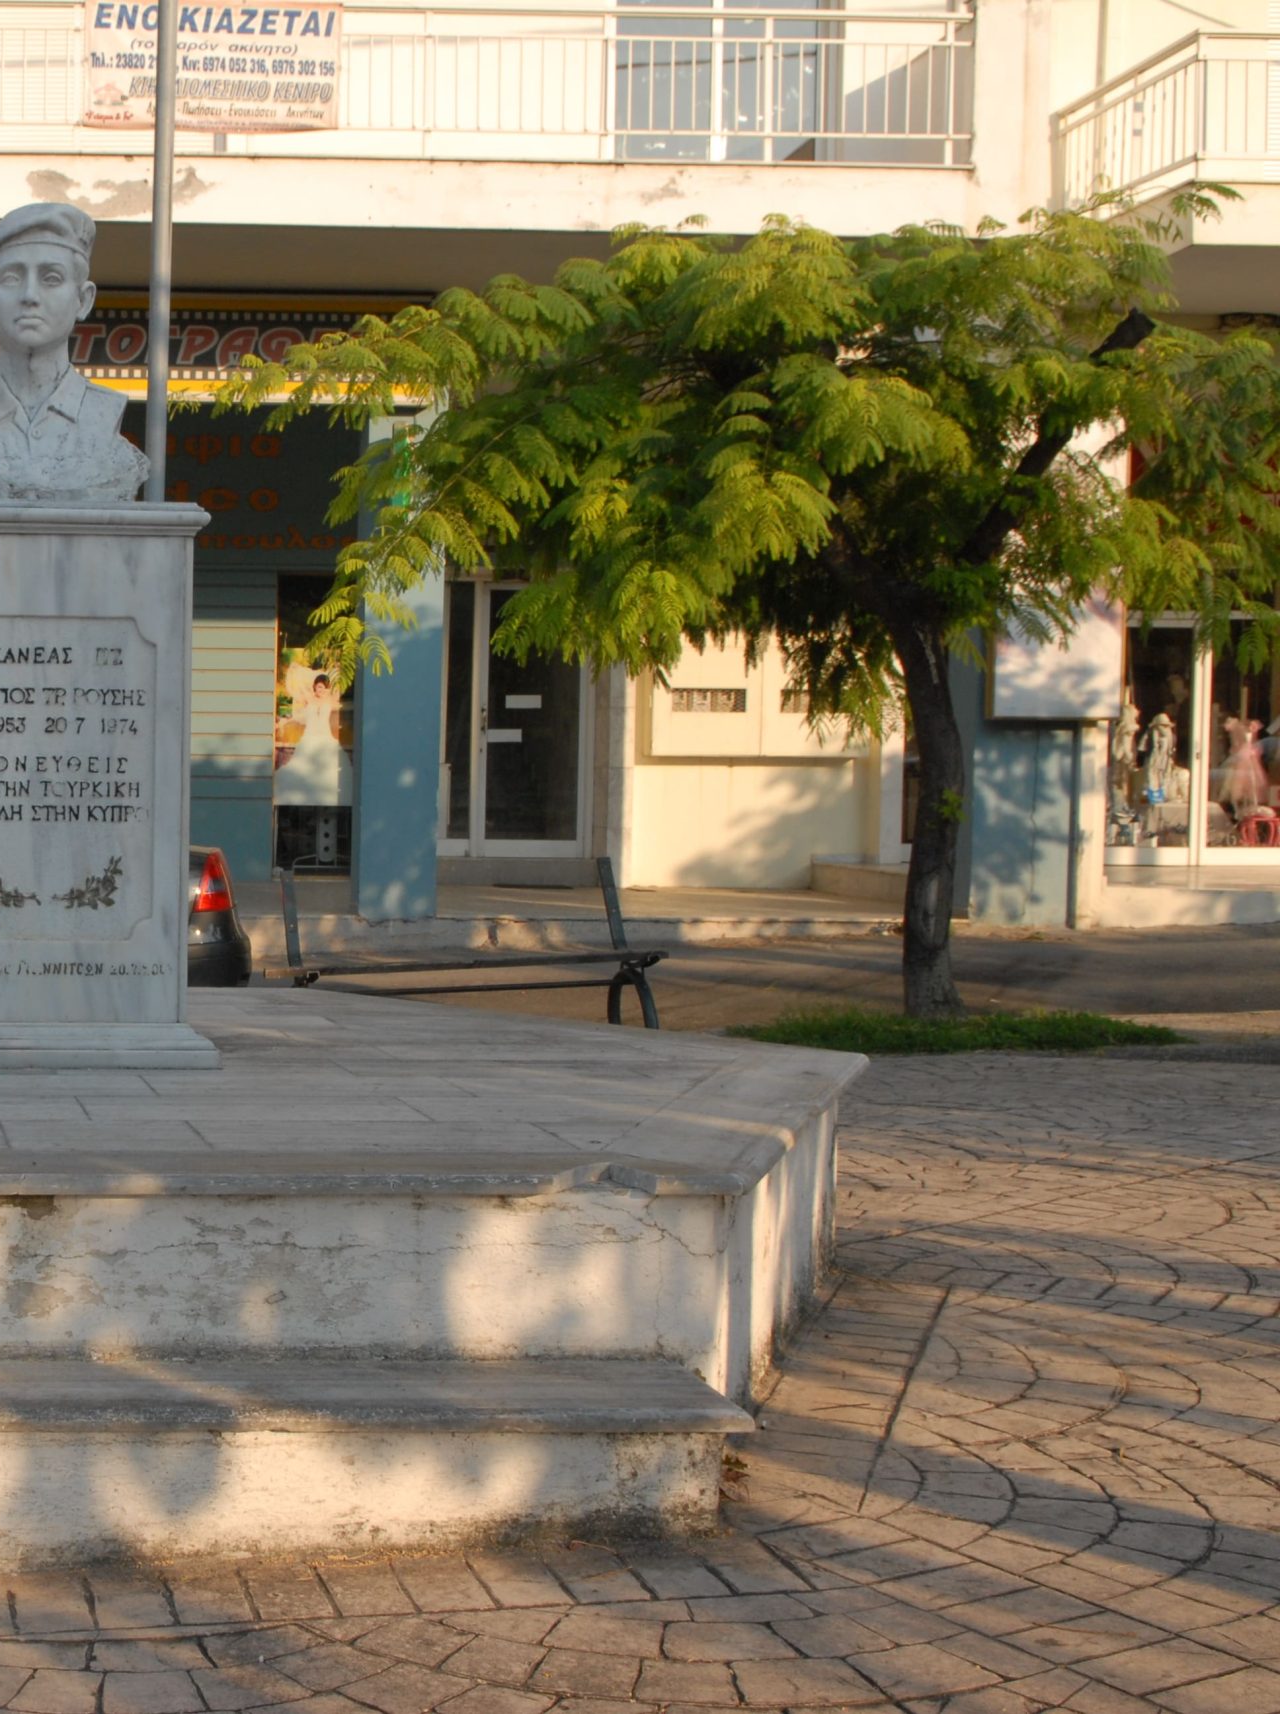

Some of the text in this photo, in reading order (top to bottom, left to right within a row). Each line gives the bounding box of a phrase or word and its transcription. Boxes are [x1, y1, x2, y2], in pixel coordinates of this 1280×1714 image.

[94, 2, 336, 37] ΕΝΟΚΙΑΖΕΤΑΙ
[176, 39, 219, 52] αρόν
[228, 42, 298, 57] ακίνητο)
[116, 53, 145, 69] 23820
[202, 56, 226, 73] 6974
[229, 58, 247, 73] 052
[272, 59, 295, 76] 6976
[298, 60, 316, 76] 302
[320, 60, 335, 77] 156
[129, 76, 271, 102] ΚΤΗΤΟΜΕΣΙΤΙΚΟ
[72, 687, 147, 706] ΡΟΥΣΗΣ
[44, 716, 68, 734] 20
[75, 717, 86, 734] 7
[100, 717, 138, 735] 1974
[40, 780, 140, 798] ΤΟΥΡΚΙΚΗ
[31, 804, 80, 822] ΣΤΗΝ
